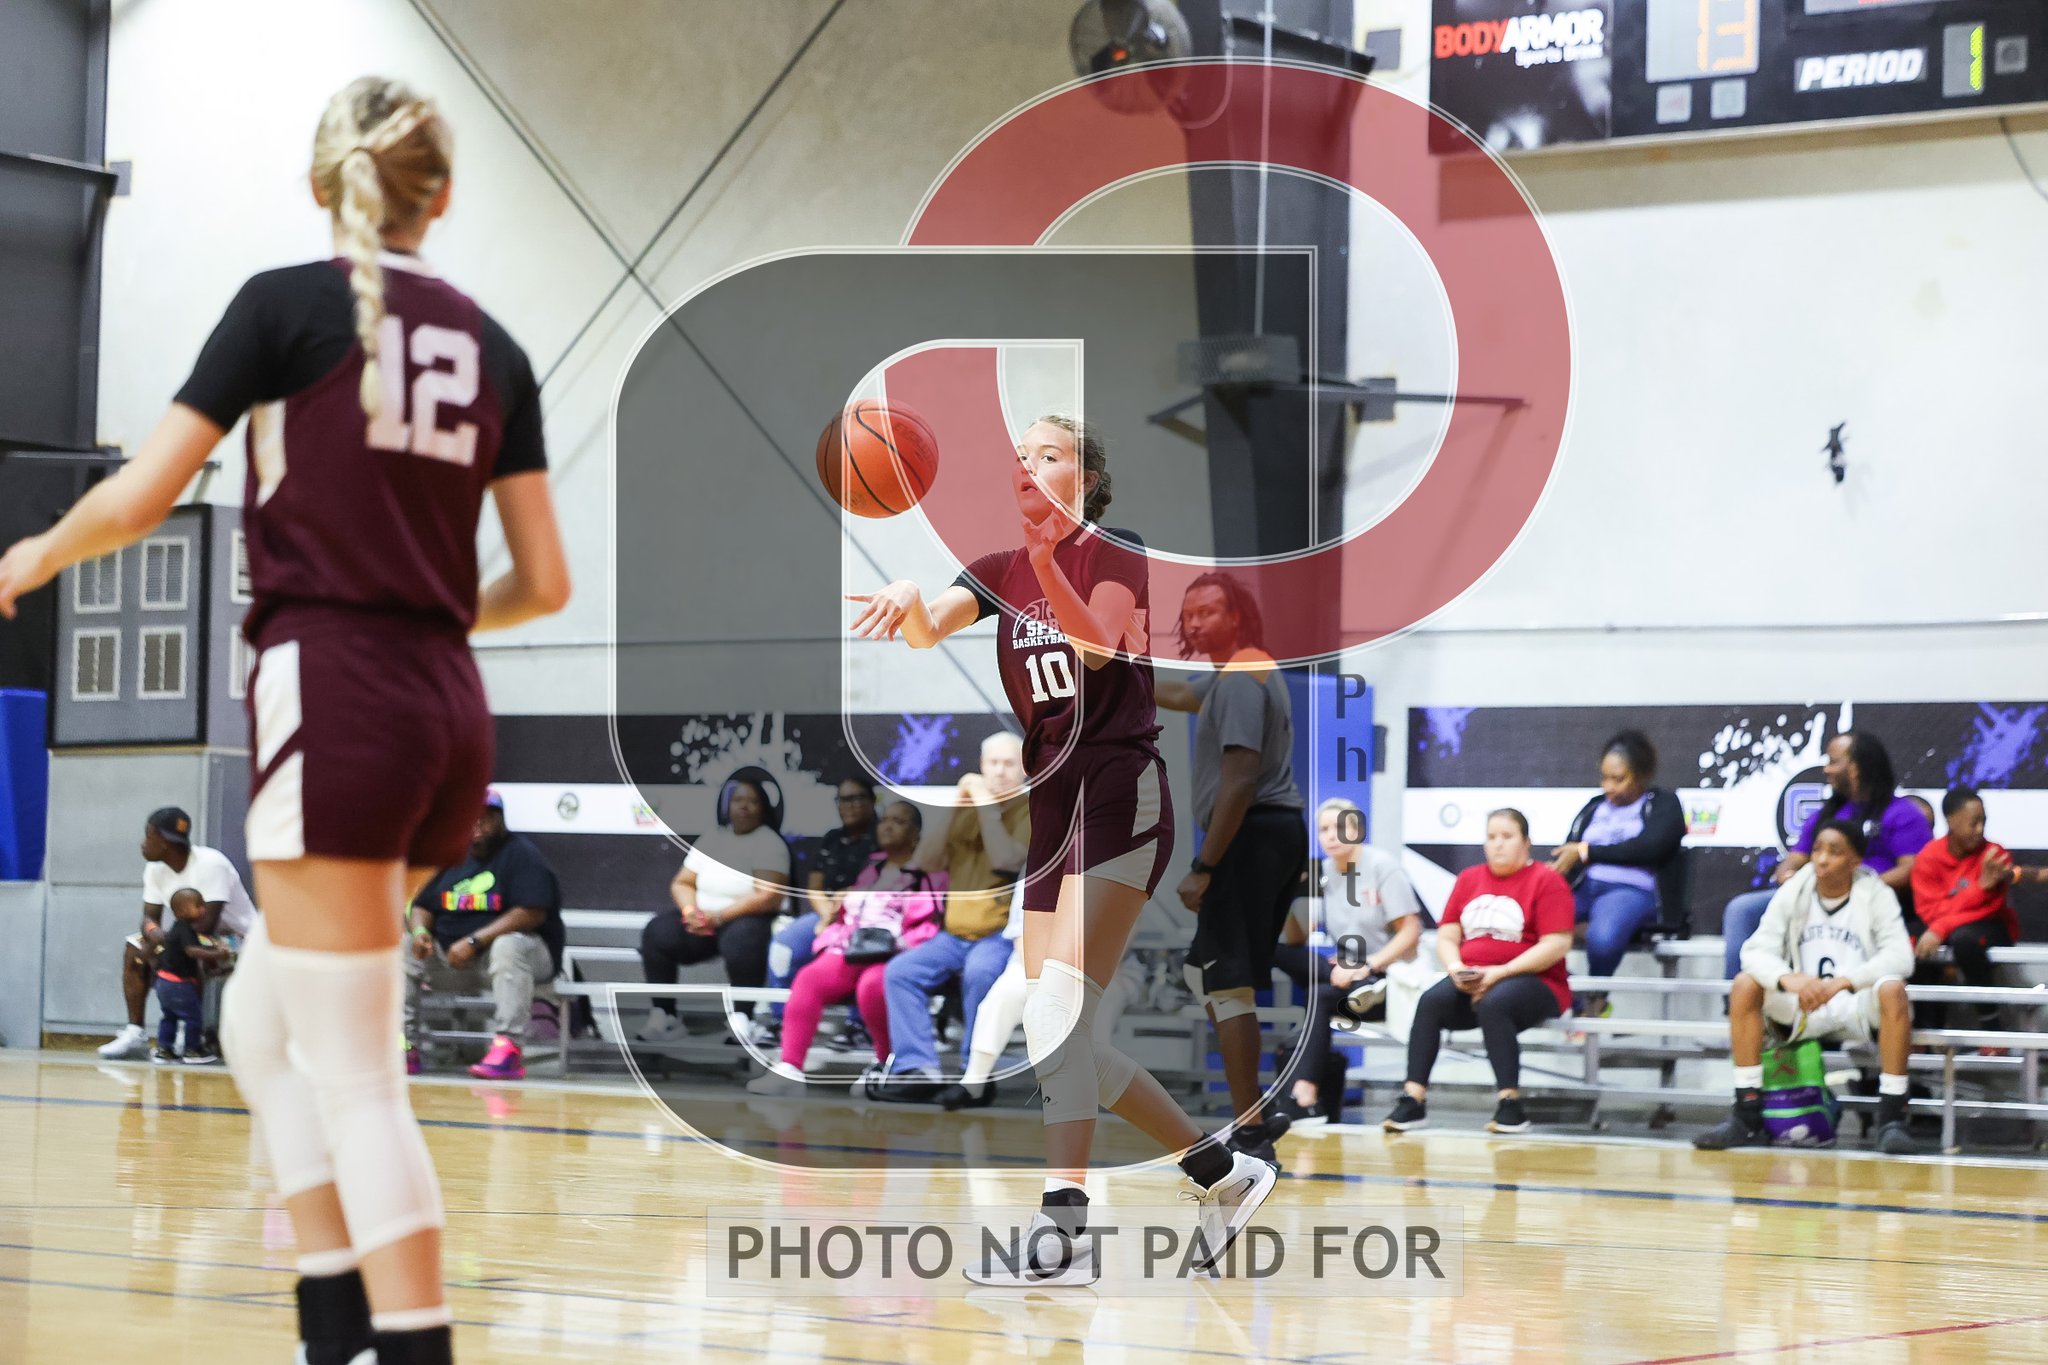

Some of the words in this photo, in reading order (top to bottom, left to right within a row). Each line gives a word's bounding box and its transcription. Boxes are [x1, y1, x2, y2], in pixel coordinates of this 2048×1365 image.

[1434, 8, 1604, 60] BODYARMOR
[1969, 24, 1984, 91] 1
[1799, 48, 1924, 91] PERIOD
[365, 314, 480, 468] 12
[1012, 632, 1070, 650] BASKETBAL
[1025, 650, 1076, 704] 10
